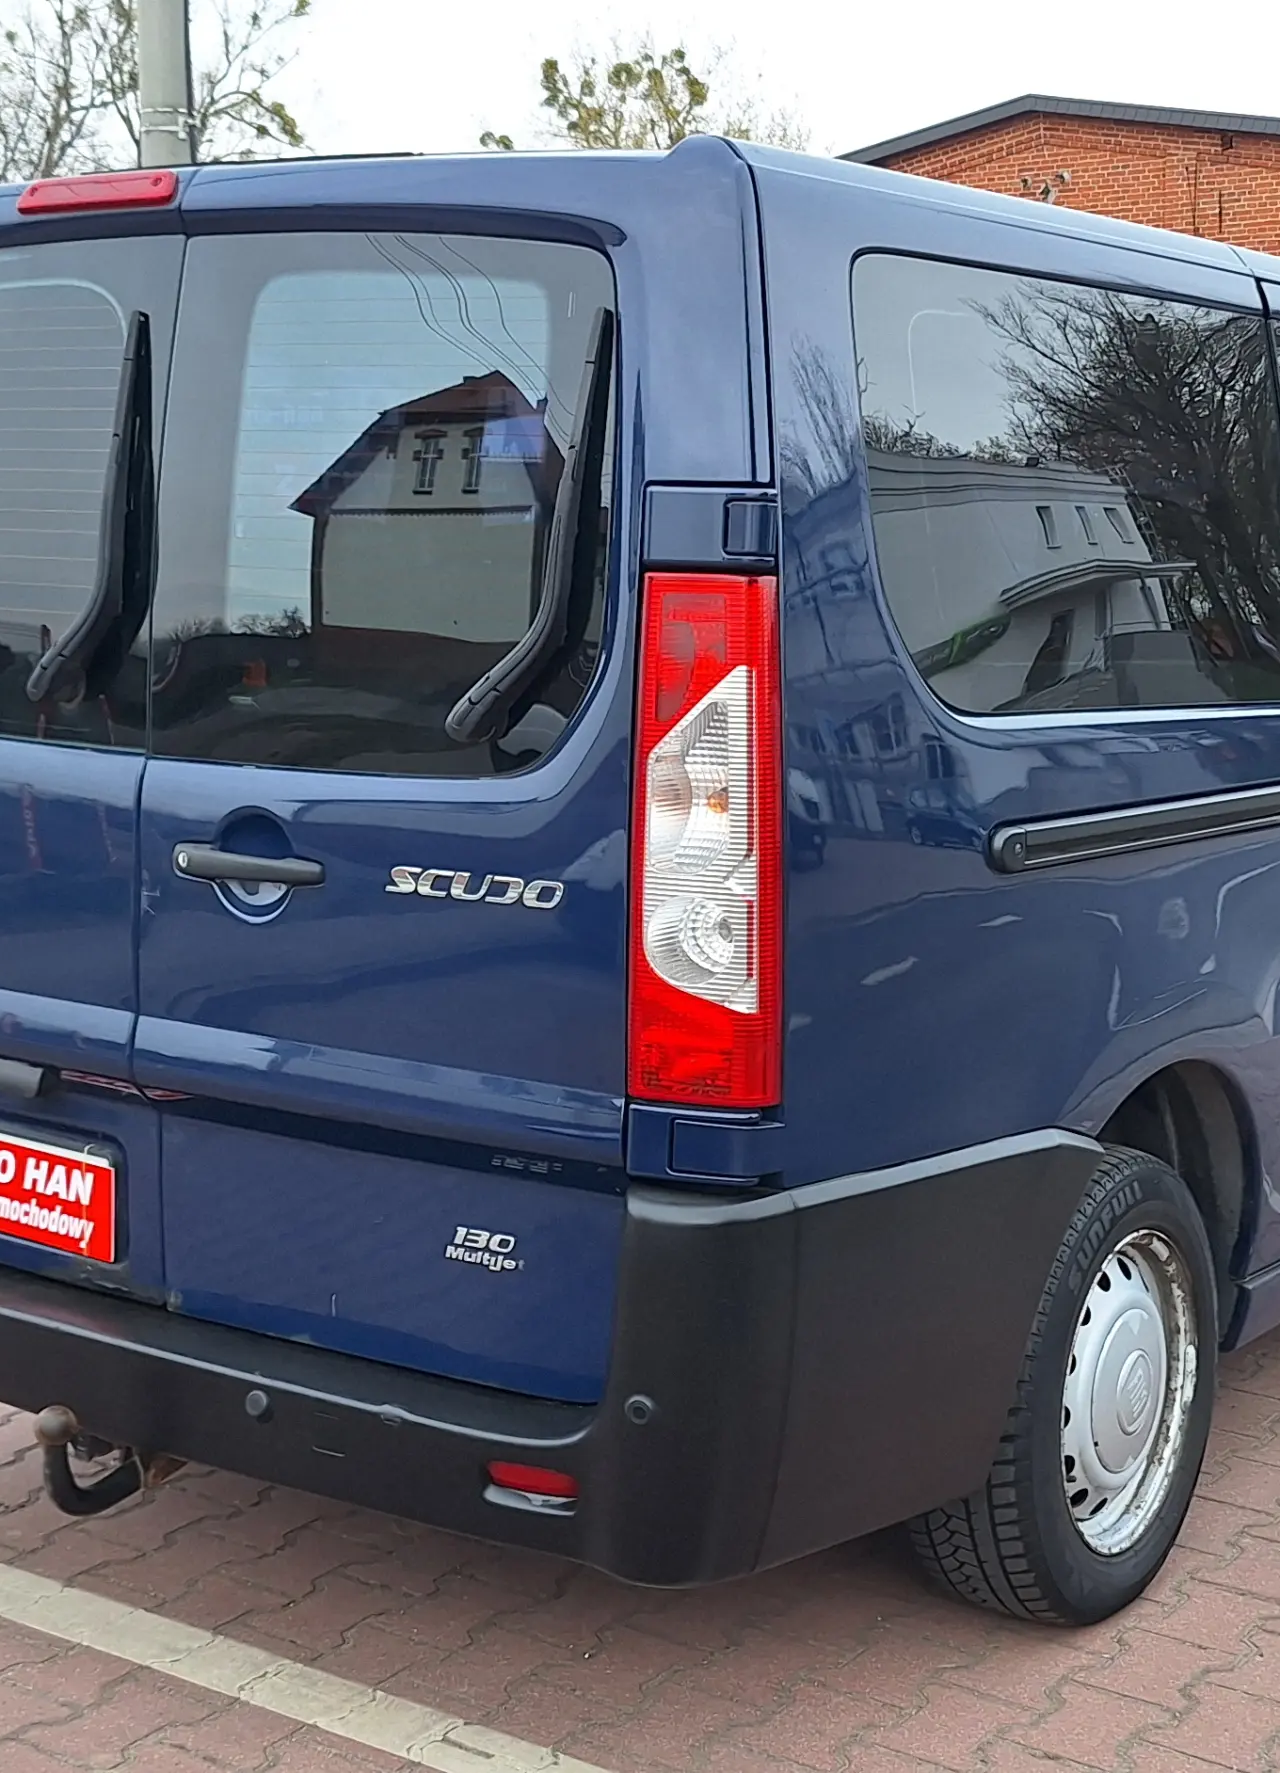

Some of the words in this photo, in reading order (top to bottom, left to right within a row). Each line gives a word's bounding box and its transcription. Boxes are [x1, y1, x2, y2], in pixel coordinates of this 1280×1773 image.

[384, 865, 565, 910] SCUDO
[23, 1157, 95, 1206] HAN
[453, 1226, 516, 1254] 130
